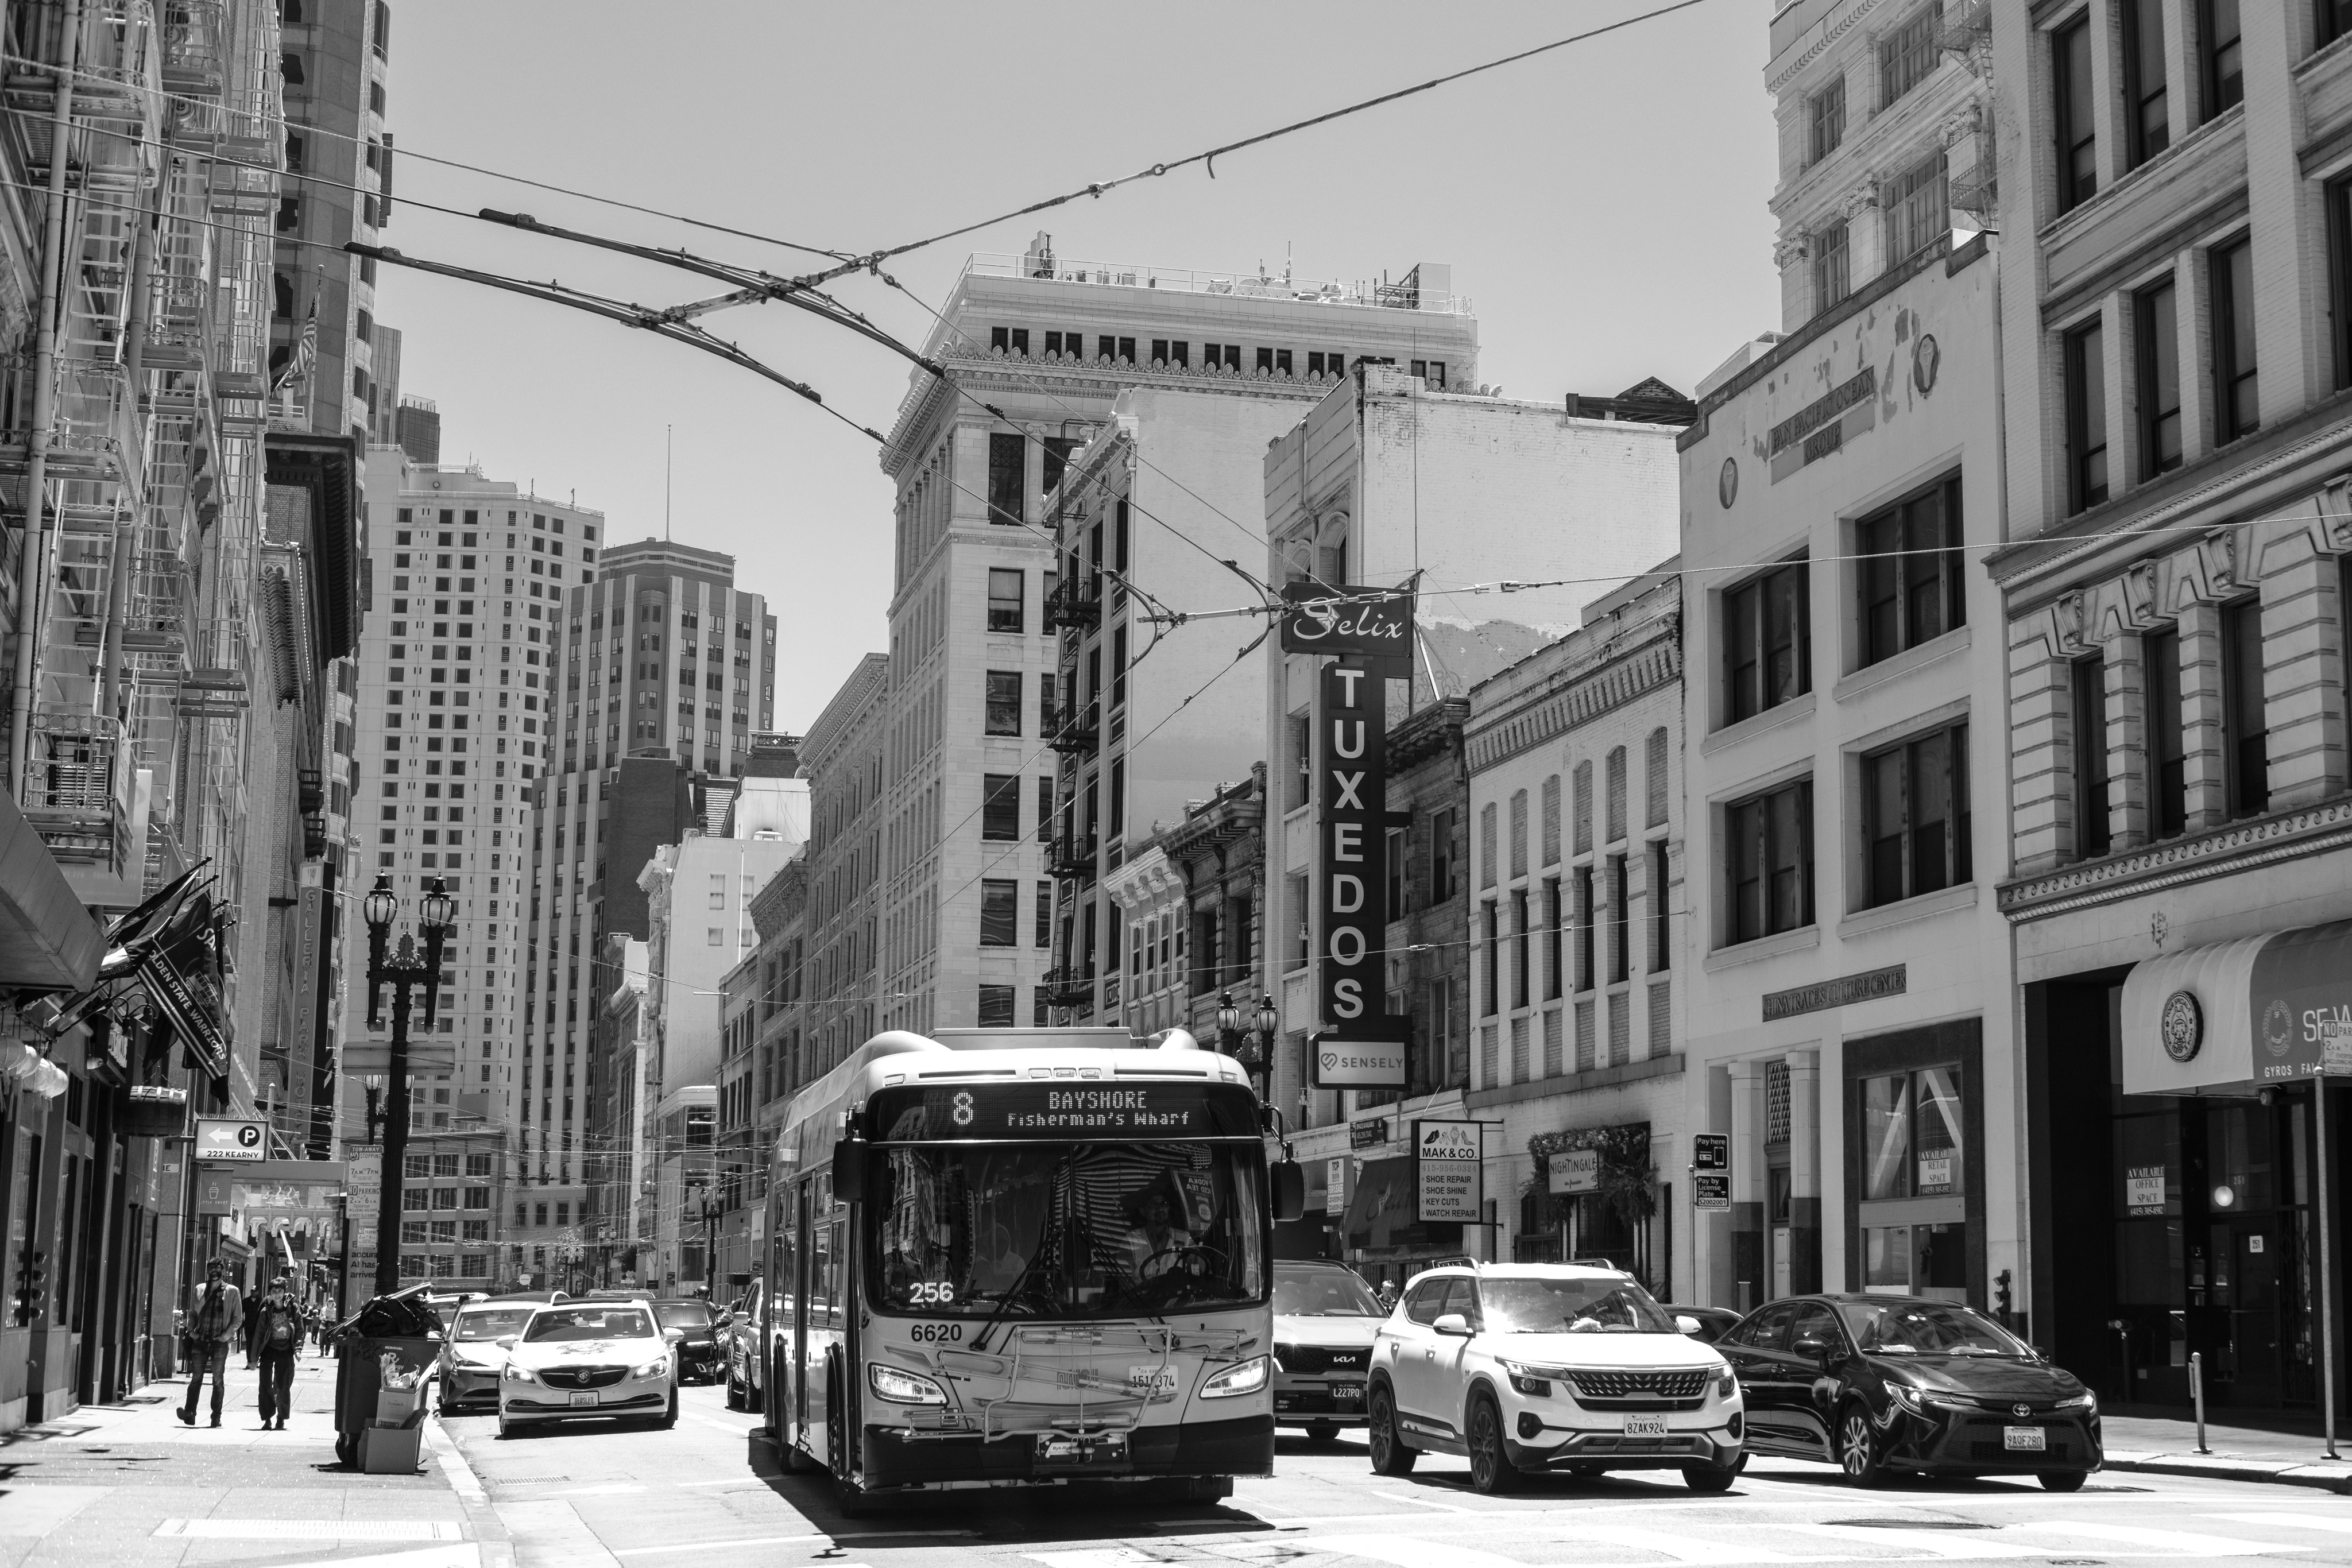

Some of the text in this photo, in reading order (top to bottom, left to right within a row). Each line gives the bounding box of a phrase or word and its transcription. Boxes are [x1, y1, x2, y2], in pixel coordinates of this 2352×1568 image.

[1773, 371, 1874, 449] PAN PACIFIC OCEAN
[1805, 425, 1841, 460] GROUP
[1293, 597, 1402, 640] Selix
[1330, 669, 1366, 1019] TUXEDOS
[300, 889, 316, 996] GALERIA
[1763, 969, 1906, 1017] CHINA TRADE & CULTURE CENTER
[148, 949, 227, 1060] OLDEN STATE WARRIORS
[297, 1006, 310, 1060] PARK
[2324, 1023, 2336, 1036] NO
[1341, 1057, 1403, 1068] SENSELY
[2264, 1065, 2292, 1078] GYROS
[953, 1091, 1147, 1125] 8 BAYSHORE
[1008, 1112, 1189, 1126] Fisherman's Wharf
[1697, 1137, 1726, 1146] Pay here
[350, 1152, 359, 1160] NO
[1422, 1148, 1477, 1159] MAK & CO.
[1920, 1148, 1950, 1161] AVAILABLE
[1332, 1161, 1340, 1172] TCP
[1421, 1164, 1477, 1172] 415-956-0324
[1550, 1157, 1596, 1175] NIGHTINGALE
[1928, 1160, 1947, 1170] RETAIL
[1929, 1173, 1946, 1183] SPACE
[2127, 1166, 2164, 1179] AVAILABLE
[1426, 1175, 1472, 1184] SHOE REPAIR
[1698, 1178, 1719, 1186] Pay by
[2136, 1178, 2159, 1189] OFFICE
[348, 1186, 357, 1195] NO
[1446, 1187, 1467, 1195] SHINE
[2137, 1193, 2158, 1203] SPACE
[1426, 1209, 1477, 1217] WATCH REPAIR
[361, 1260, 376, 1268] has
[910, 1281, 954, 1303] 256
[911, 1323, 962, 1342] 6620
[1132, 1375, 1175, 1388] 151374
[1627, 1423, 1665, 1434] 8ZAK924
